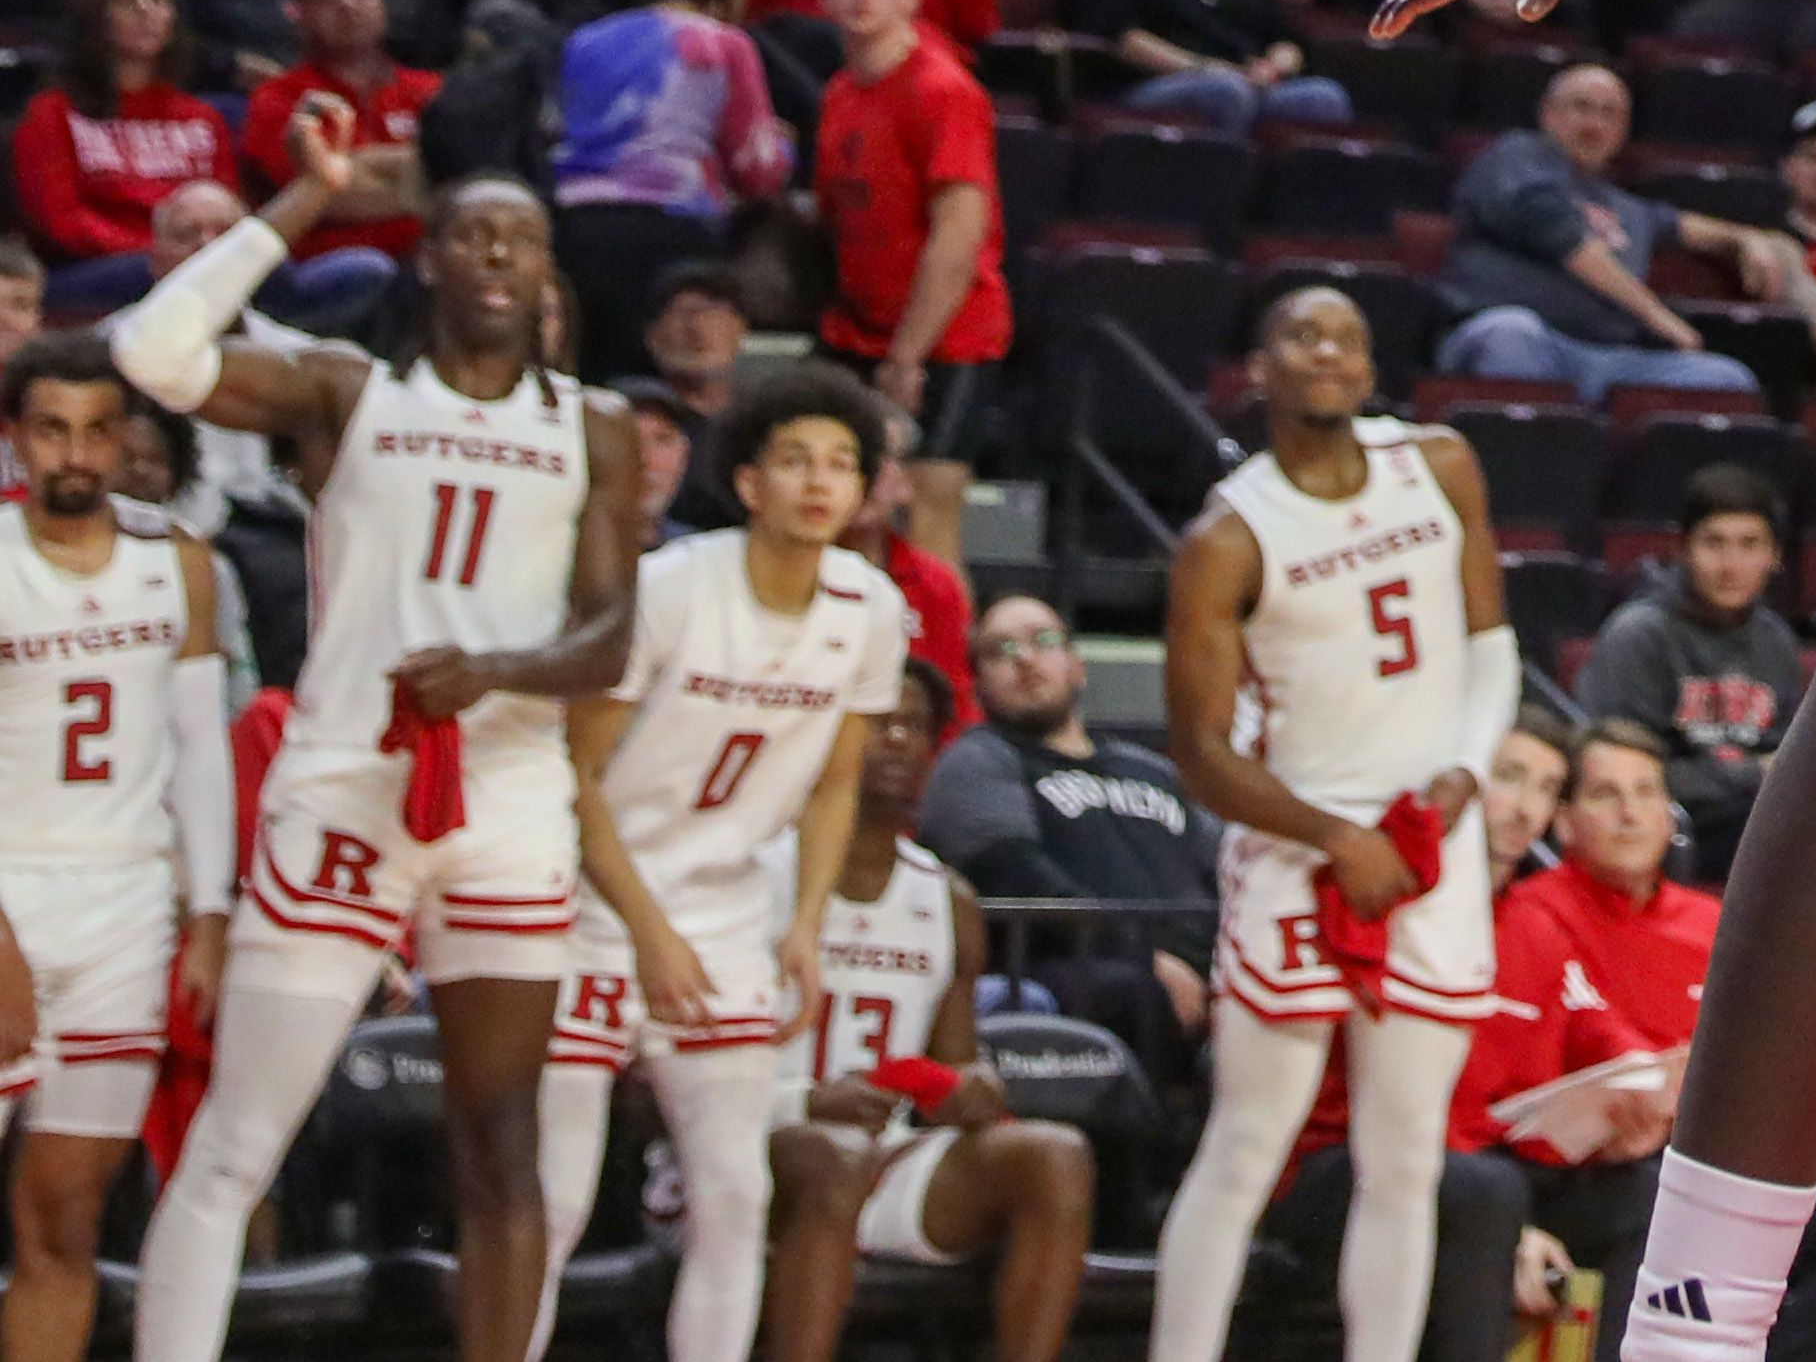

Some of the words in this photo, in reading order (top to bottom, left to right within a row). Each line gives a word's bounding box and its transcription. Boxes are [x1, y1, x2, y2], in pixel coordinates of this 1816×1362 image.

[373, 431, 567, 477] RUTGERS
[426, 483, 496, 585] 11
[1288, 521, 1442, 586] RUTGERS
[0, 621, 178, 666] RUTGERS
[1369, 580, 1417, 677] 5
[63, 681, 113, 781] 2
[696, 733, 765, 810] 0
[312, 830, 380, 896] R
[571, 975, 627, 1028] R
[813, 991, 893, 1081] 13
